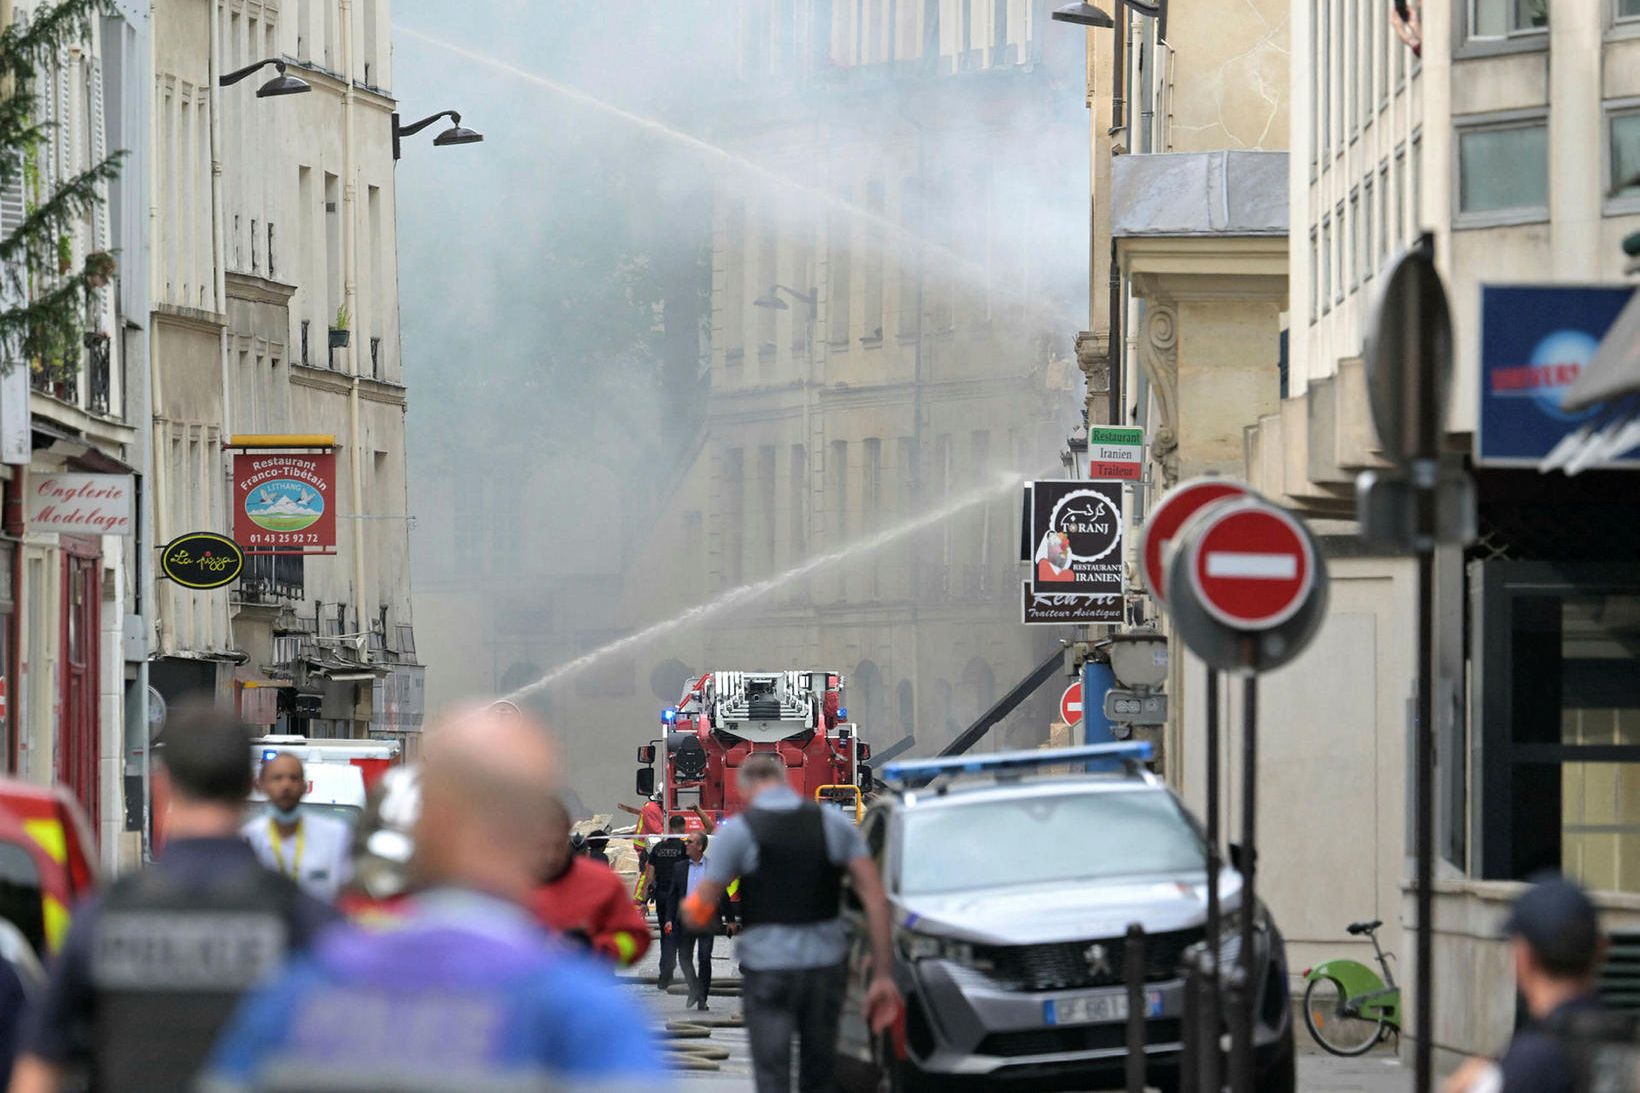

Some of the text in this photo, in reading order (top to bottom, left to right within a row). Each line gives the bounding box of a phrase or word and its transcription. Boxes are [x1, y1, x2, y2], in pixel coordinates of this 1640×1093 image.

[1093, 430, 1140, 443] Restaurant
[1100, 448, 1132, 460] Iranien
[252, 457, 317, 471] Restaurant
[1097, 464, 1133, 477] Traiteur
[240, 466, 327, 491] Franco-Tibétain
[37, 479, 123, 503] Onglerie
[267, 482, 302, 492] LITHANG
[31, 505, 129, 531] Modelage
[250, 534, 318, 543] 01 43 25 92 72
[170, 549, 238, 571] La pizza
[1073, 564, 1122, 572] RESTAURANT
[1076, 573, 1121, 582] IRANIEN
[1028, 607, 1121, 620] Traiteur Asiatique
